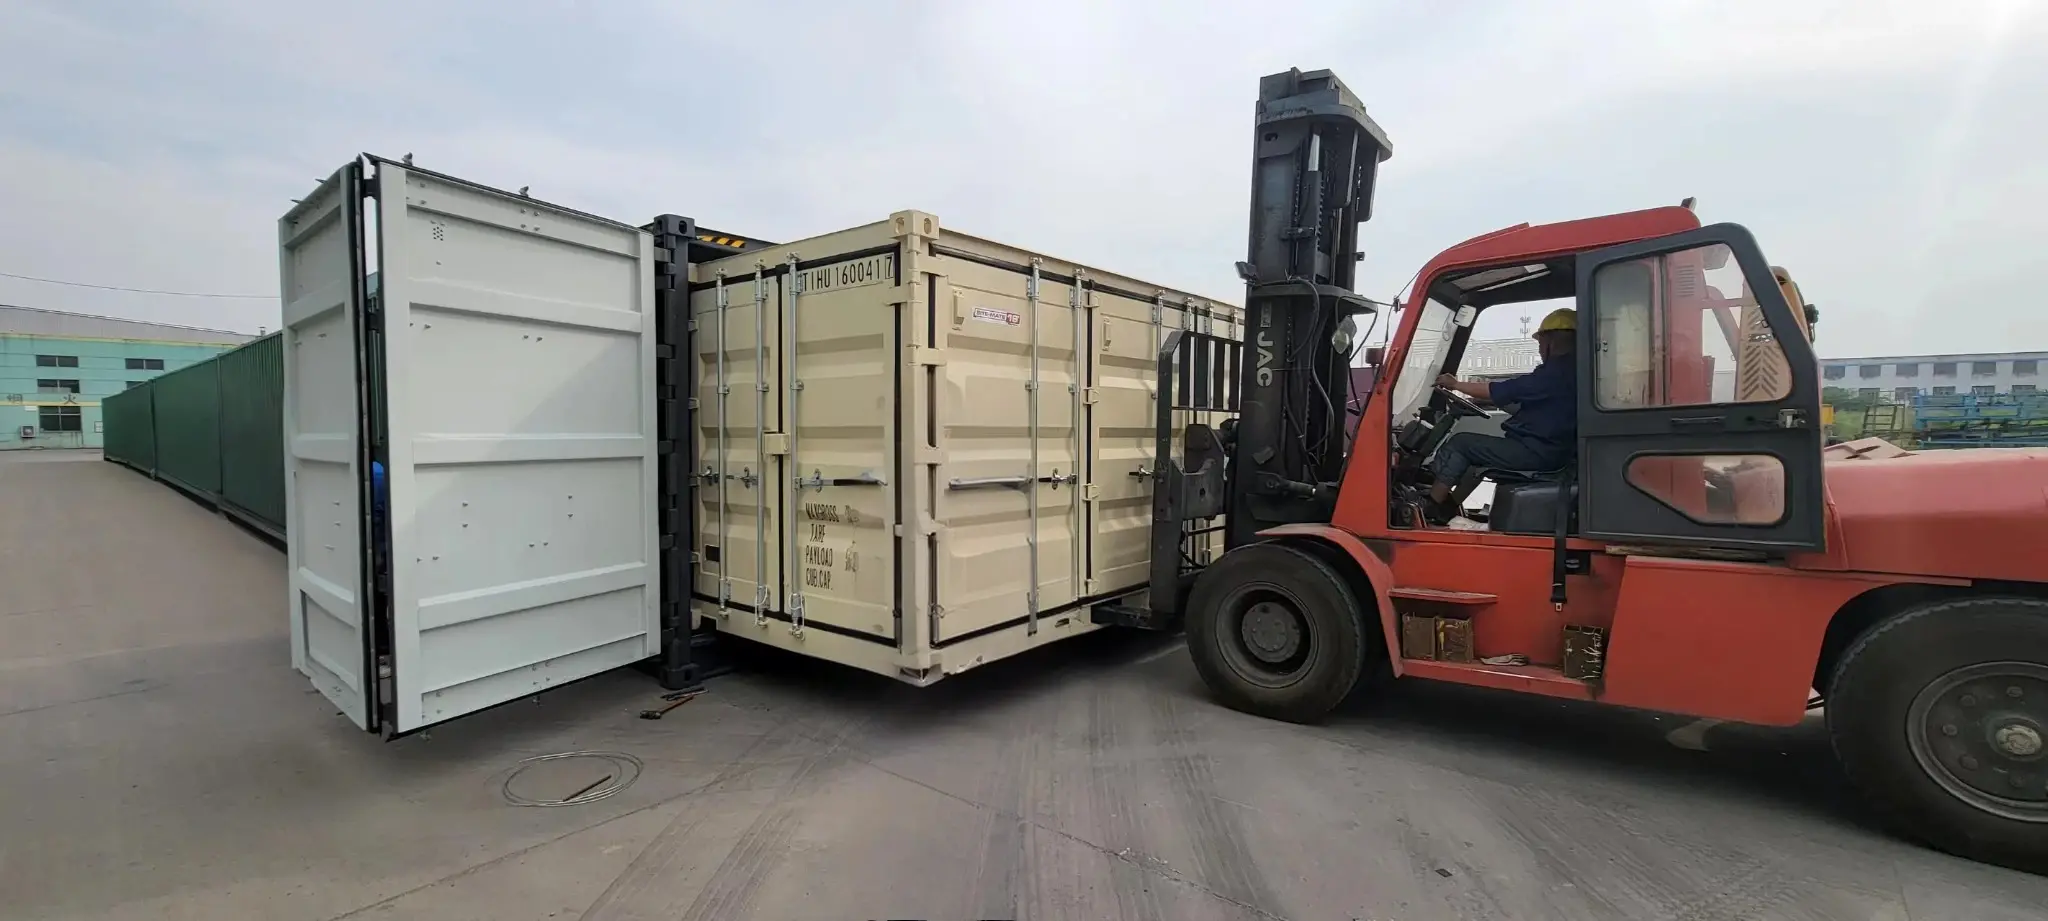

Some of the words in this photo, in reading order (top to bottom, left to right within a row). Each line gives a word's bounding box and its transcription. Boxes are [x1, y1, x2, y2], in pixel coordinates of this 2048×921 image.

[803, 268, 831, 291] TIHU
[1257, 331, 1274, 387] JAC
[805, 545, 833, 568] PAYLOAD
